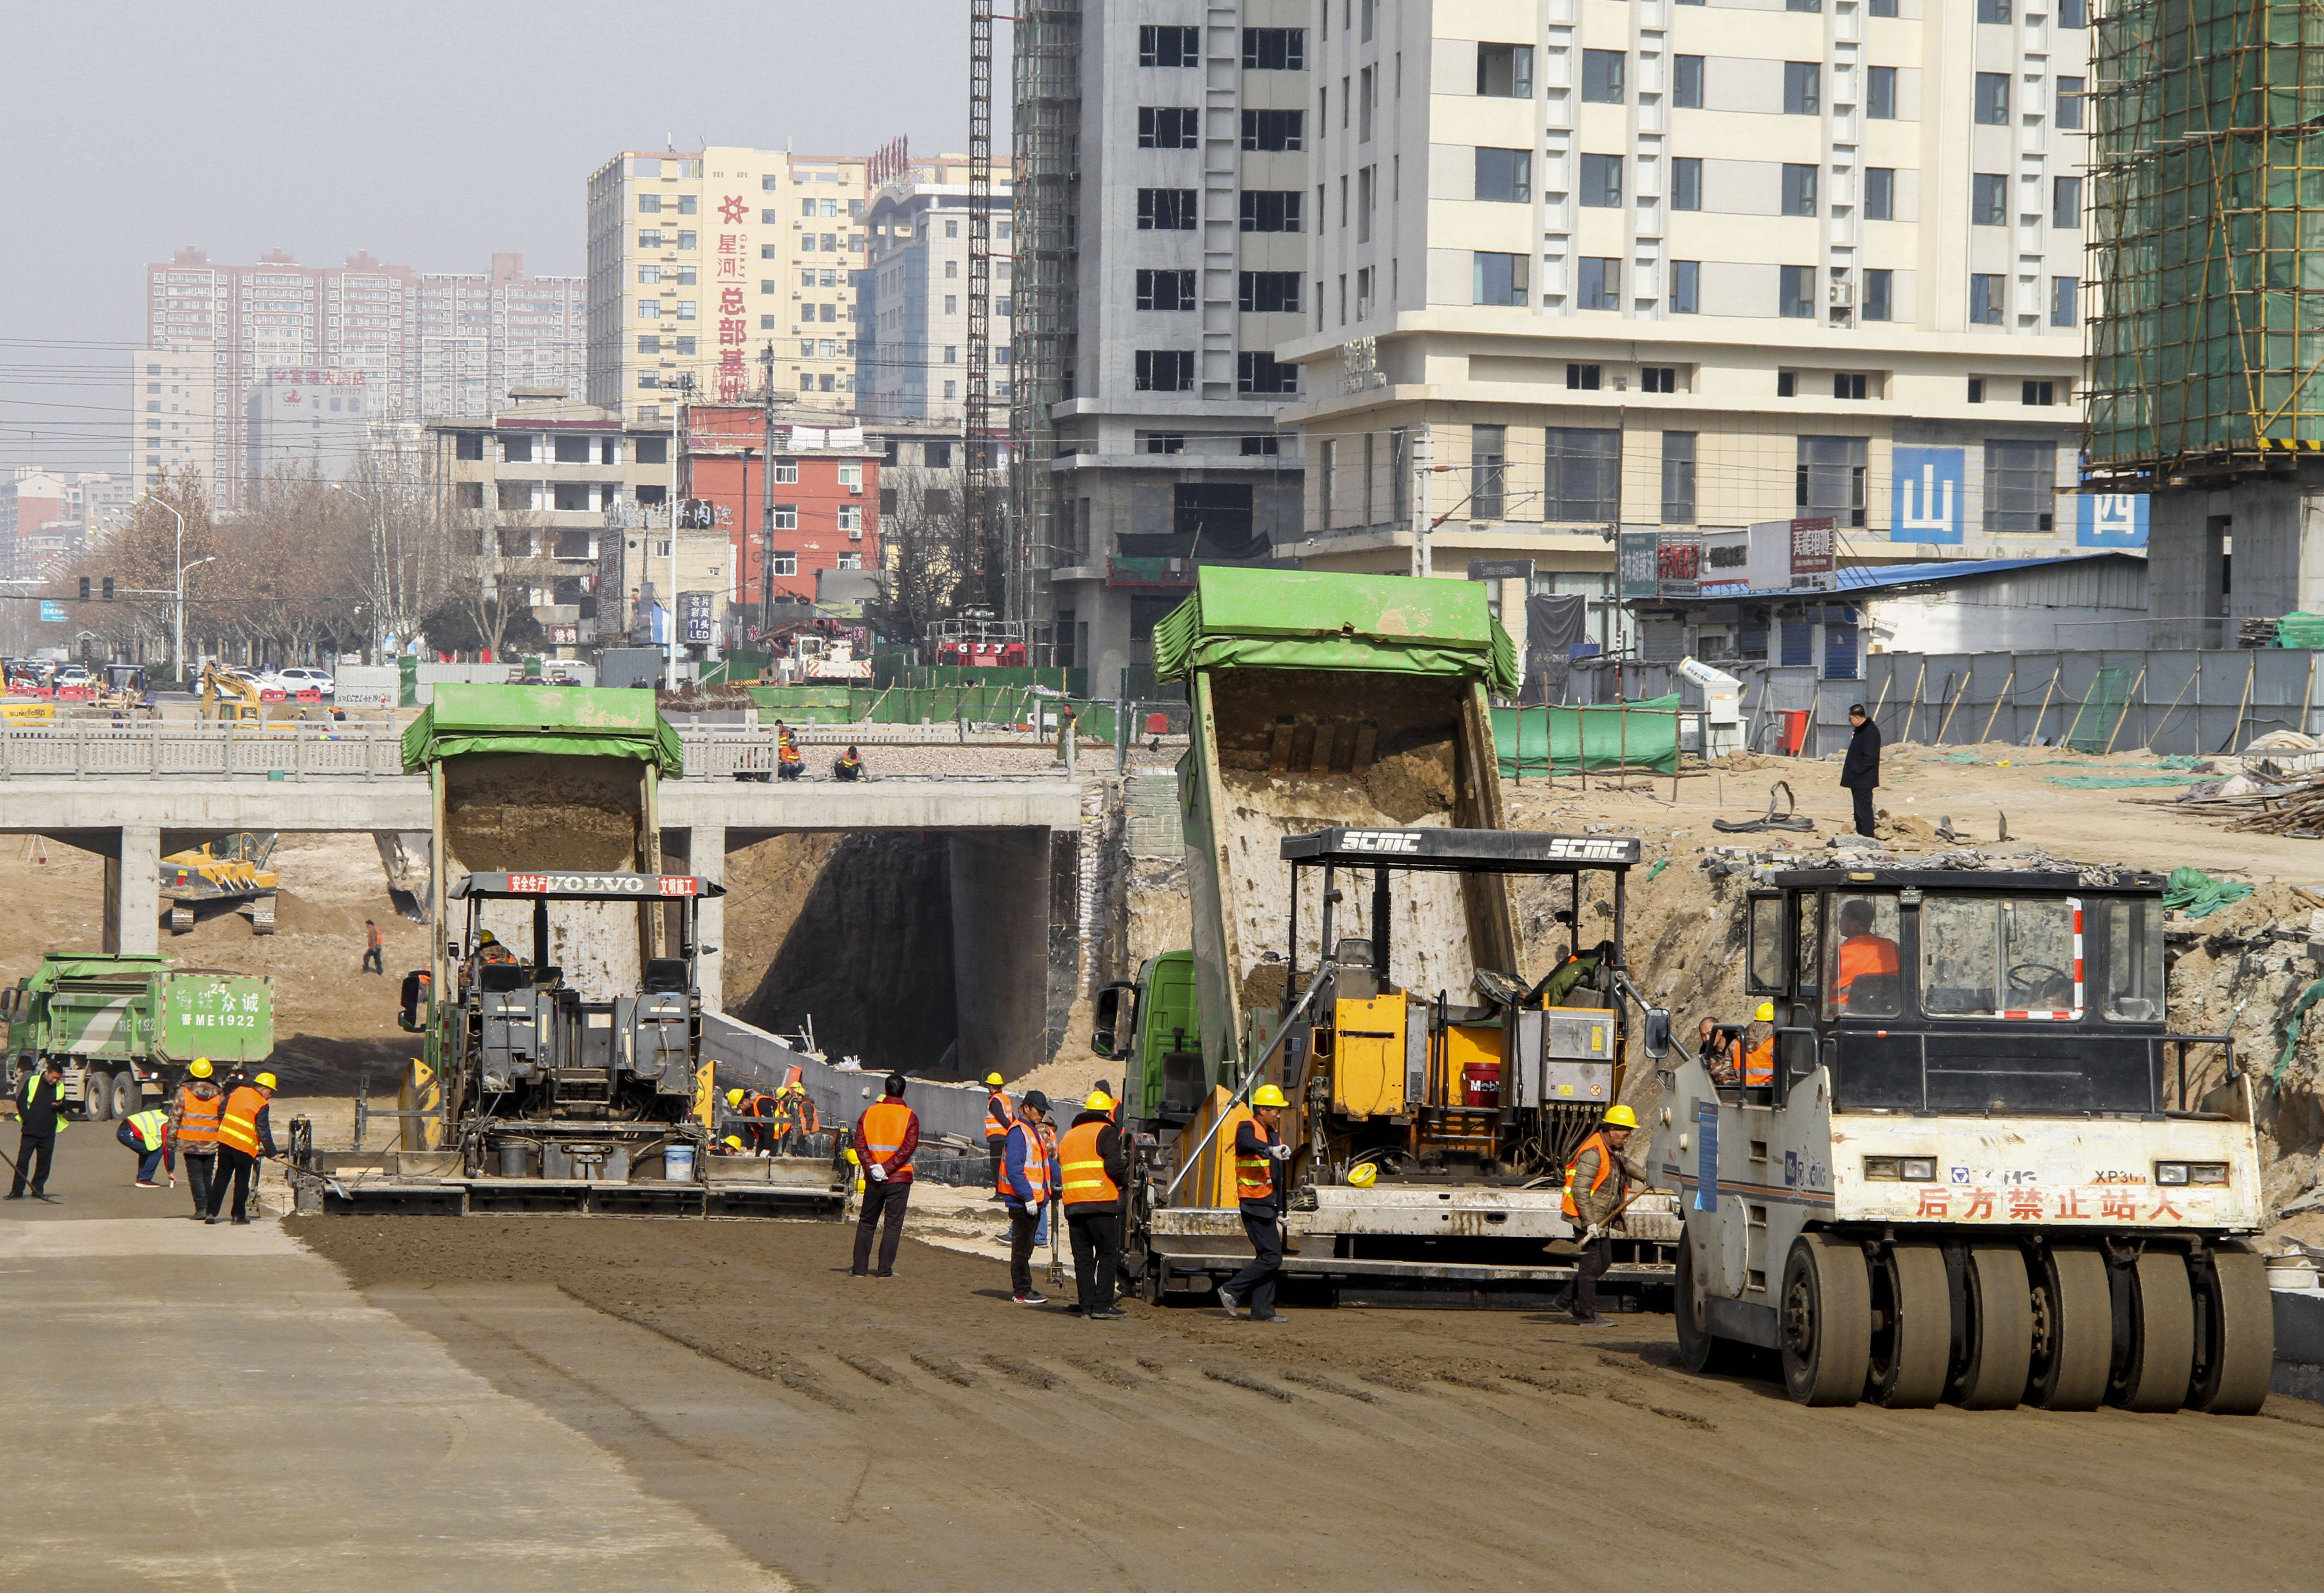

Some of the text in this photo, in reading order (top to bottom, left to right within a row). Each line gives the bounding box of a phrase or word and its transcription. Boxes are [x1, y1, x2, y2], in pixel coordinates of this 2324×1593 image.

[717, 234, 737, 277] 星河
[738, 234, 747, 278] Galaxy
[718, 287, 747, 404] 总部基地
[1903, 464, 1953, 531] 山
[1621, 549, 1654, 582] 肉胡辣汤
[690, 619, 709, 629] 门头
[690, 630, 709, 639] LED
[958, 644, 1005, 653] GJJ
[1548, 839, 1629, 859] SCMC
[512, 875, 547, 892] 安全生产
[548, 876, 644, 892] VOLVO
[660, 877, 693, 895] 文明施工
[210, 983, 227, 994] 24
[181, 1014, 255, 1027] 晋ME1922
[1916, 1187, 2184, 1222] 后方禁止站人
